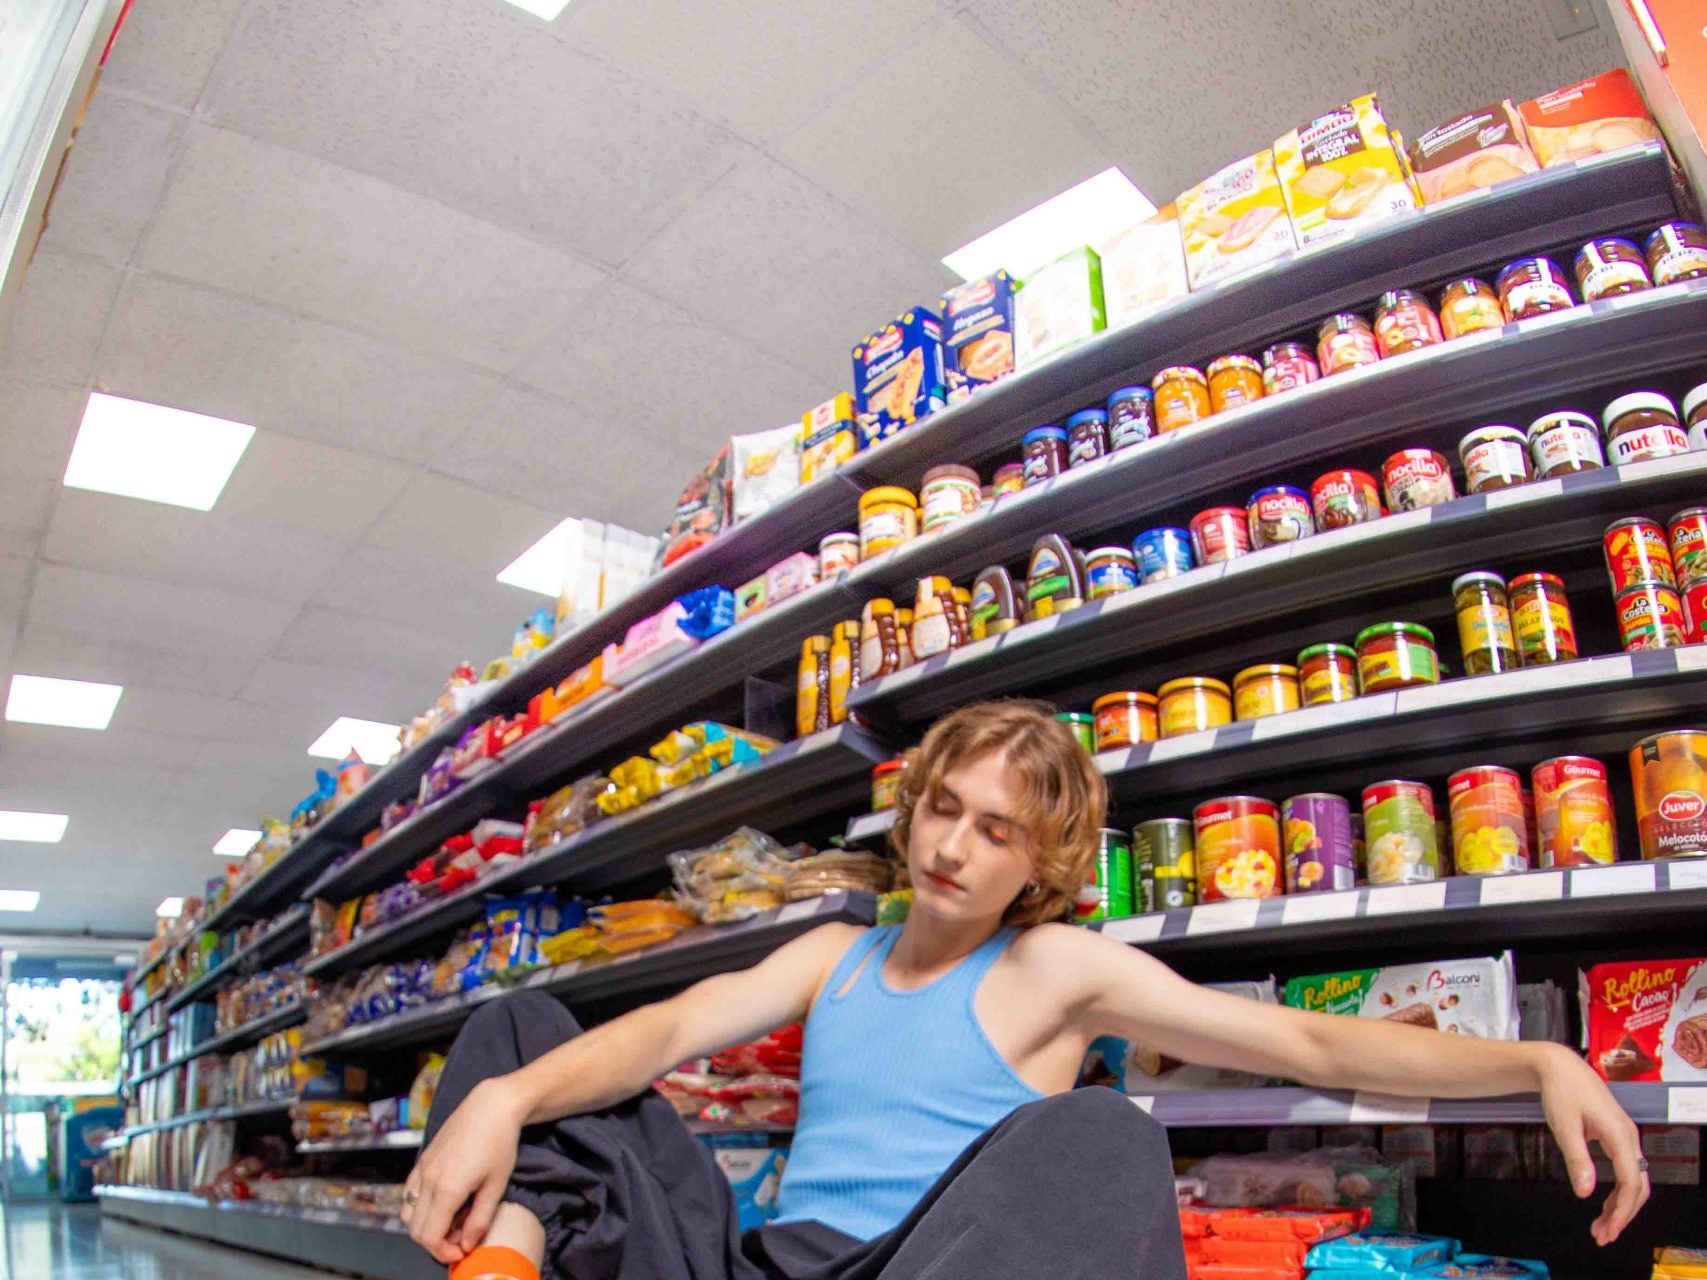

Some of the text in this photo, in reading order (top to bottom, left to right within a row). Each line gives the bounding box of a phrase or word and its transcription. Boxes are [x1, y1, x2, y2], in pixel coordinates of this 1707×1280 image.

[1305, 132, 1360, 162] INTEGRAL
[1541, 430, 1582, 449] nutea
[1388, 458, 1437, 482] nocilla
[1261, 495, 1306, 513] nocilla
[1623, 602, 1666, 620] Costea
[1663, 800, 1700, 815] Juver
[1658, 831, 1707, 848] Melocotó
[1304, 975, 1362, 1009] Rollino
[1426, 969, 1481, 992] Balconi
[1603, 967, 1677, 1004] Rollino
[1632, 989, 1671, 1012] Cacao
